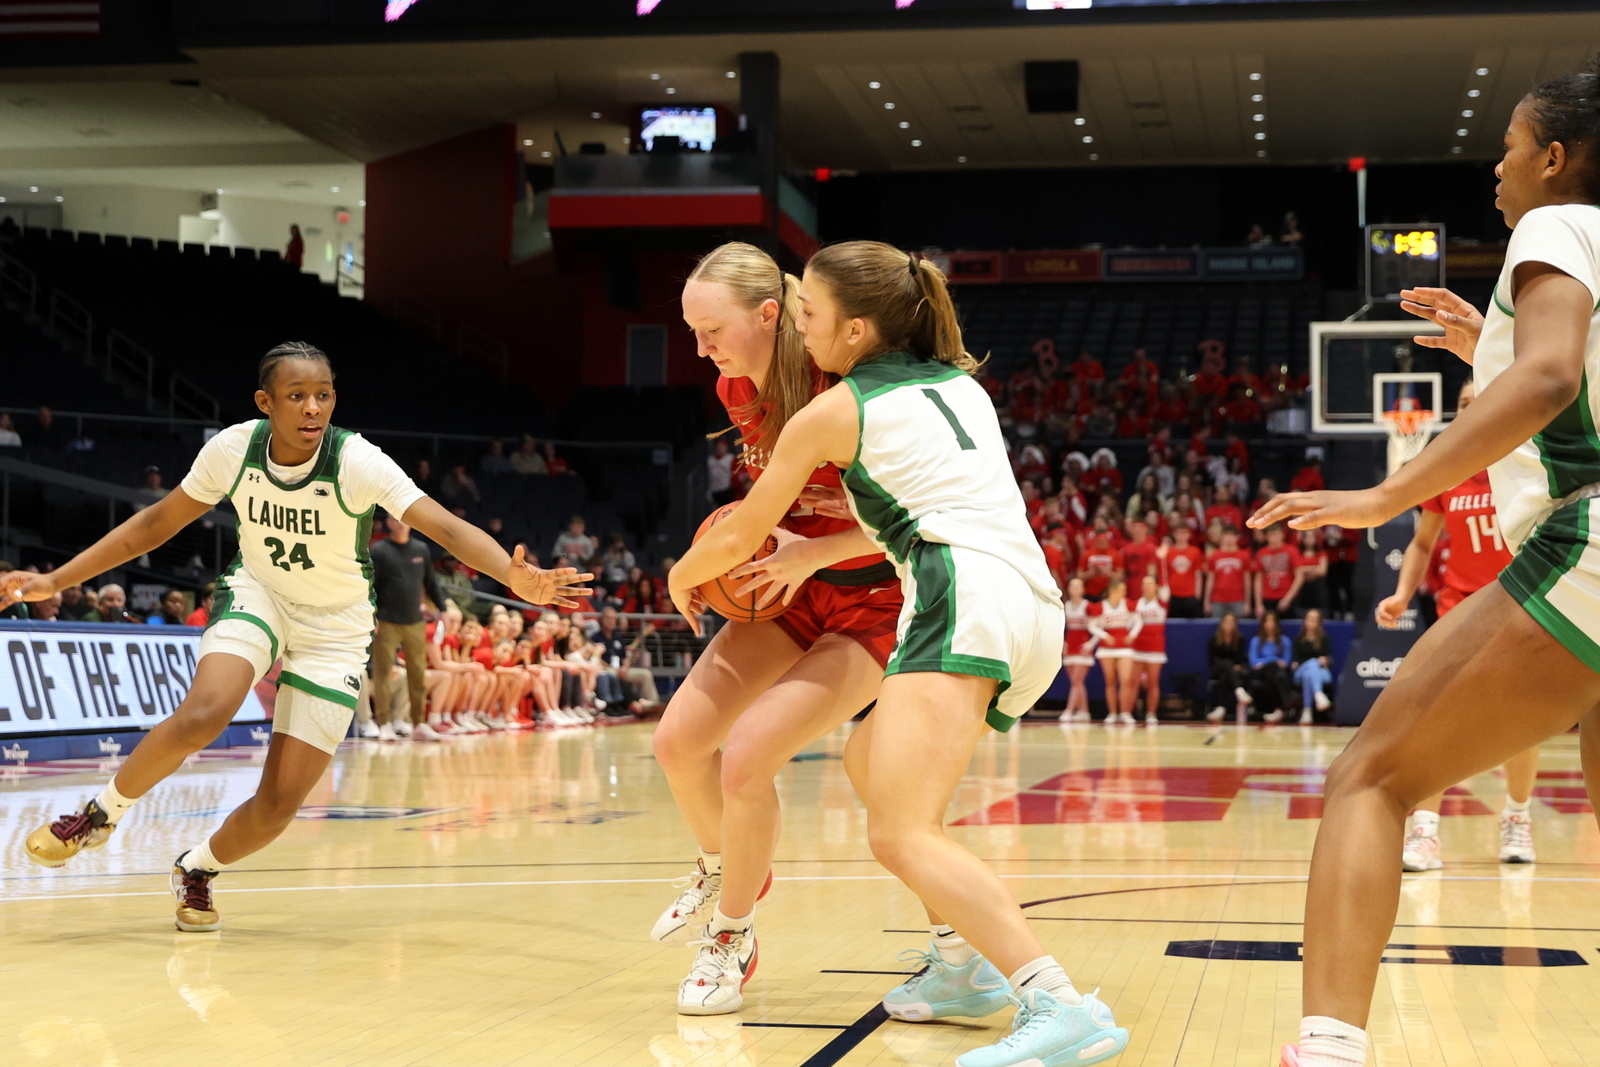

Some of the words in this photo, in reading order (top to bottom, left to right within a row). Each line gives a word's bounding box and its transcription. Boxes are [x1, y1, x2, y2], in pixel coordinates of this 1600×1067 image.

[1394, 231, 1437, 256] 1:56
[920, 388, 977, 450] 1
[248, 496, 326, 535] LAUREL
[1465, 513, 1504, 553] 14
[264, 536, 315, 572] 24
[8, 640, 56, 720] OF
[58, 641, 130, 718] THE
